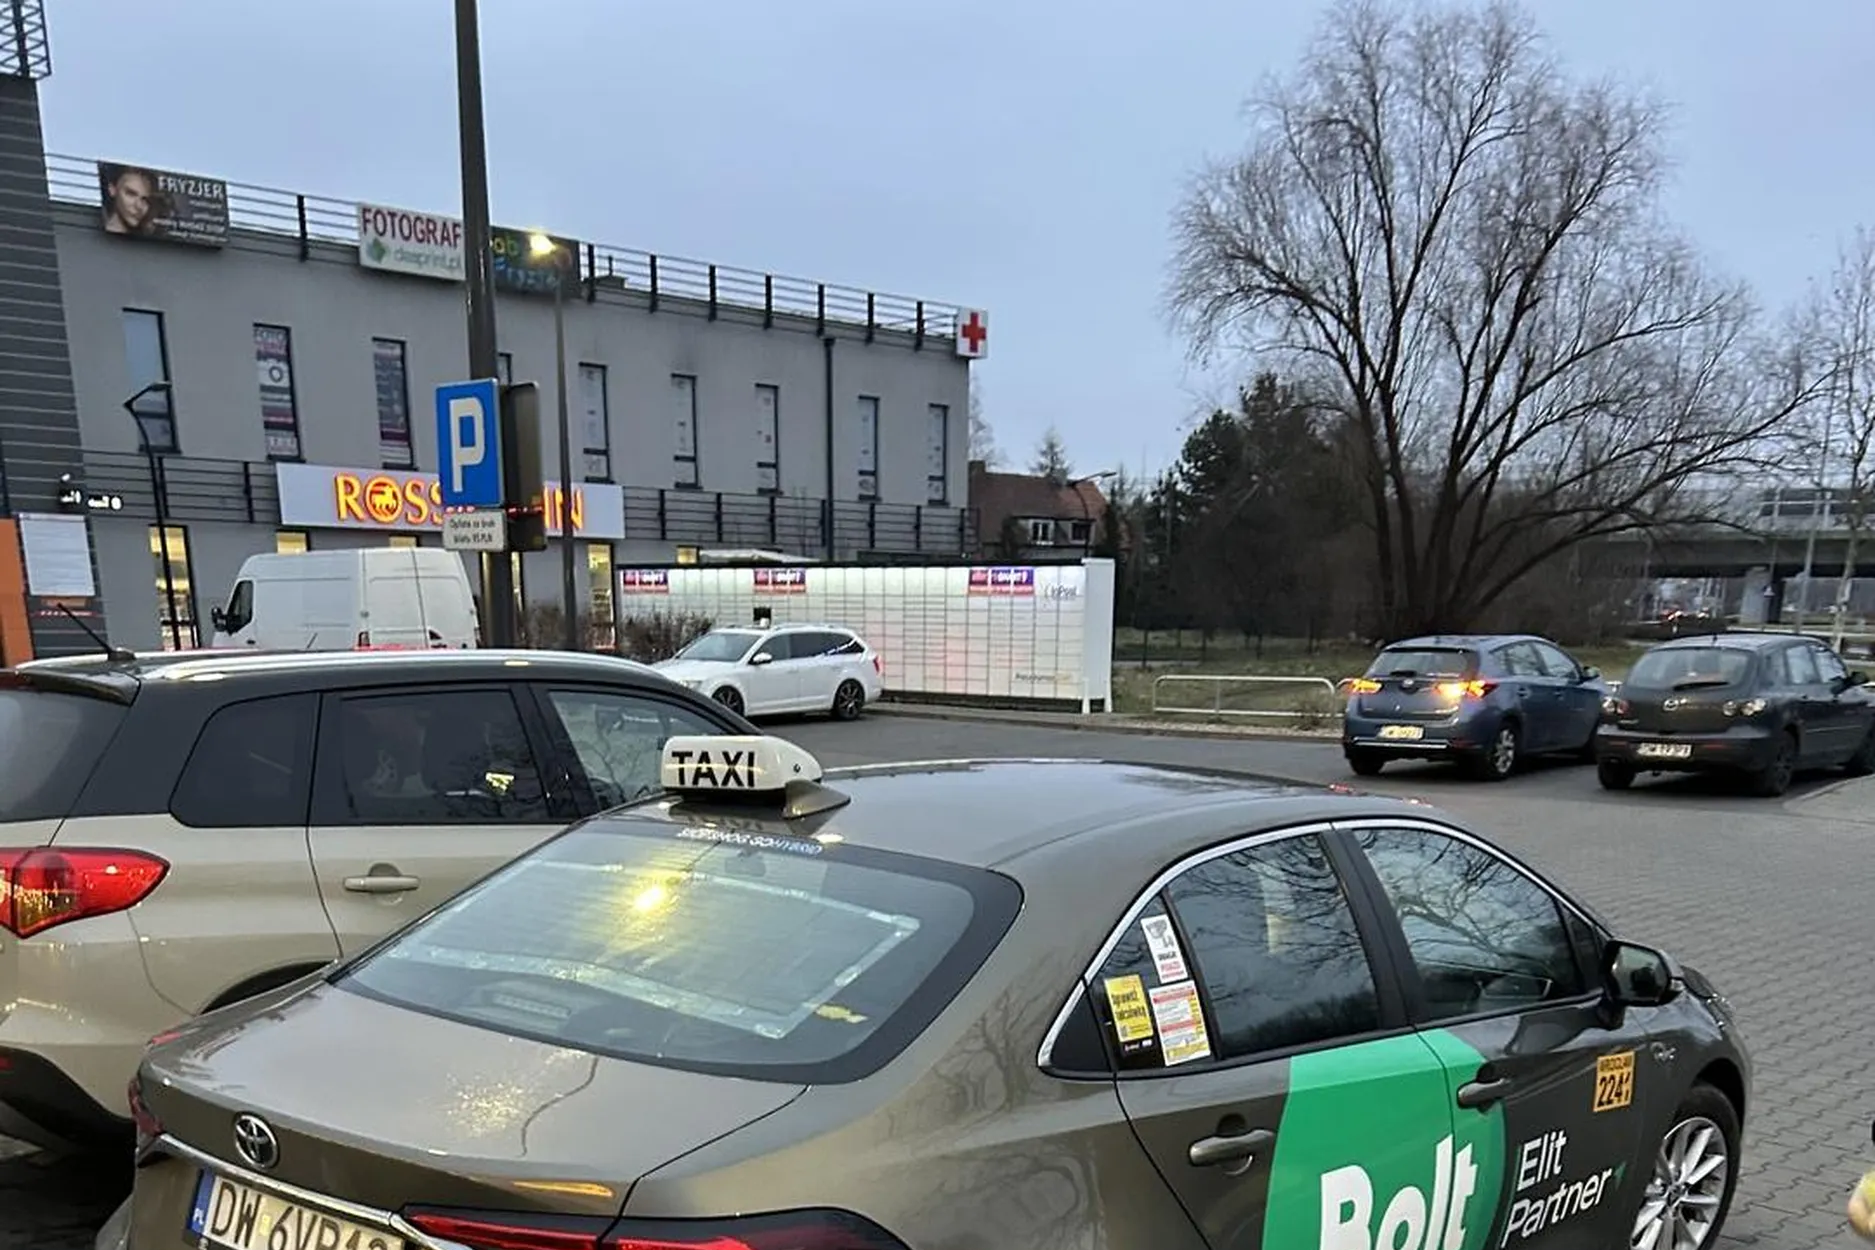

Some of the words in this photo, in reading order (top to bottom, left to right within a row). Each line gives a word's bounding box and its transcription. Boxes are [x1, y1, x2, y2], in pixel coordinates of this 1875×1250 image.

[158, 176, 223, 199] FRYZJER
[361, 207, 462, 250] FOTOGRAF
[449, 397, 485, 493] P
[671, 751, 755, 788] TAXI
[1517, 1130, 1567, 1192] Elit
[210, 1181, 262, 1248] DW
[1500, 1168, 1613, 1249] Partner
